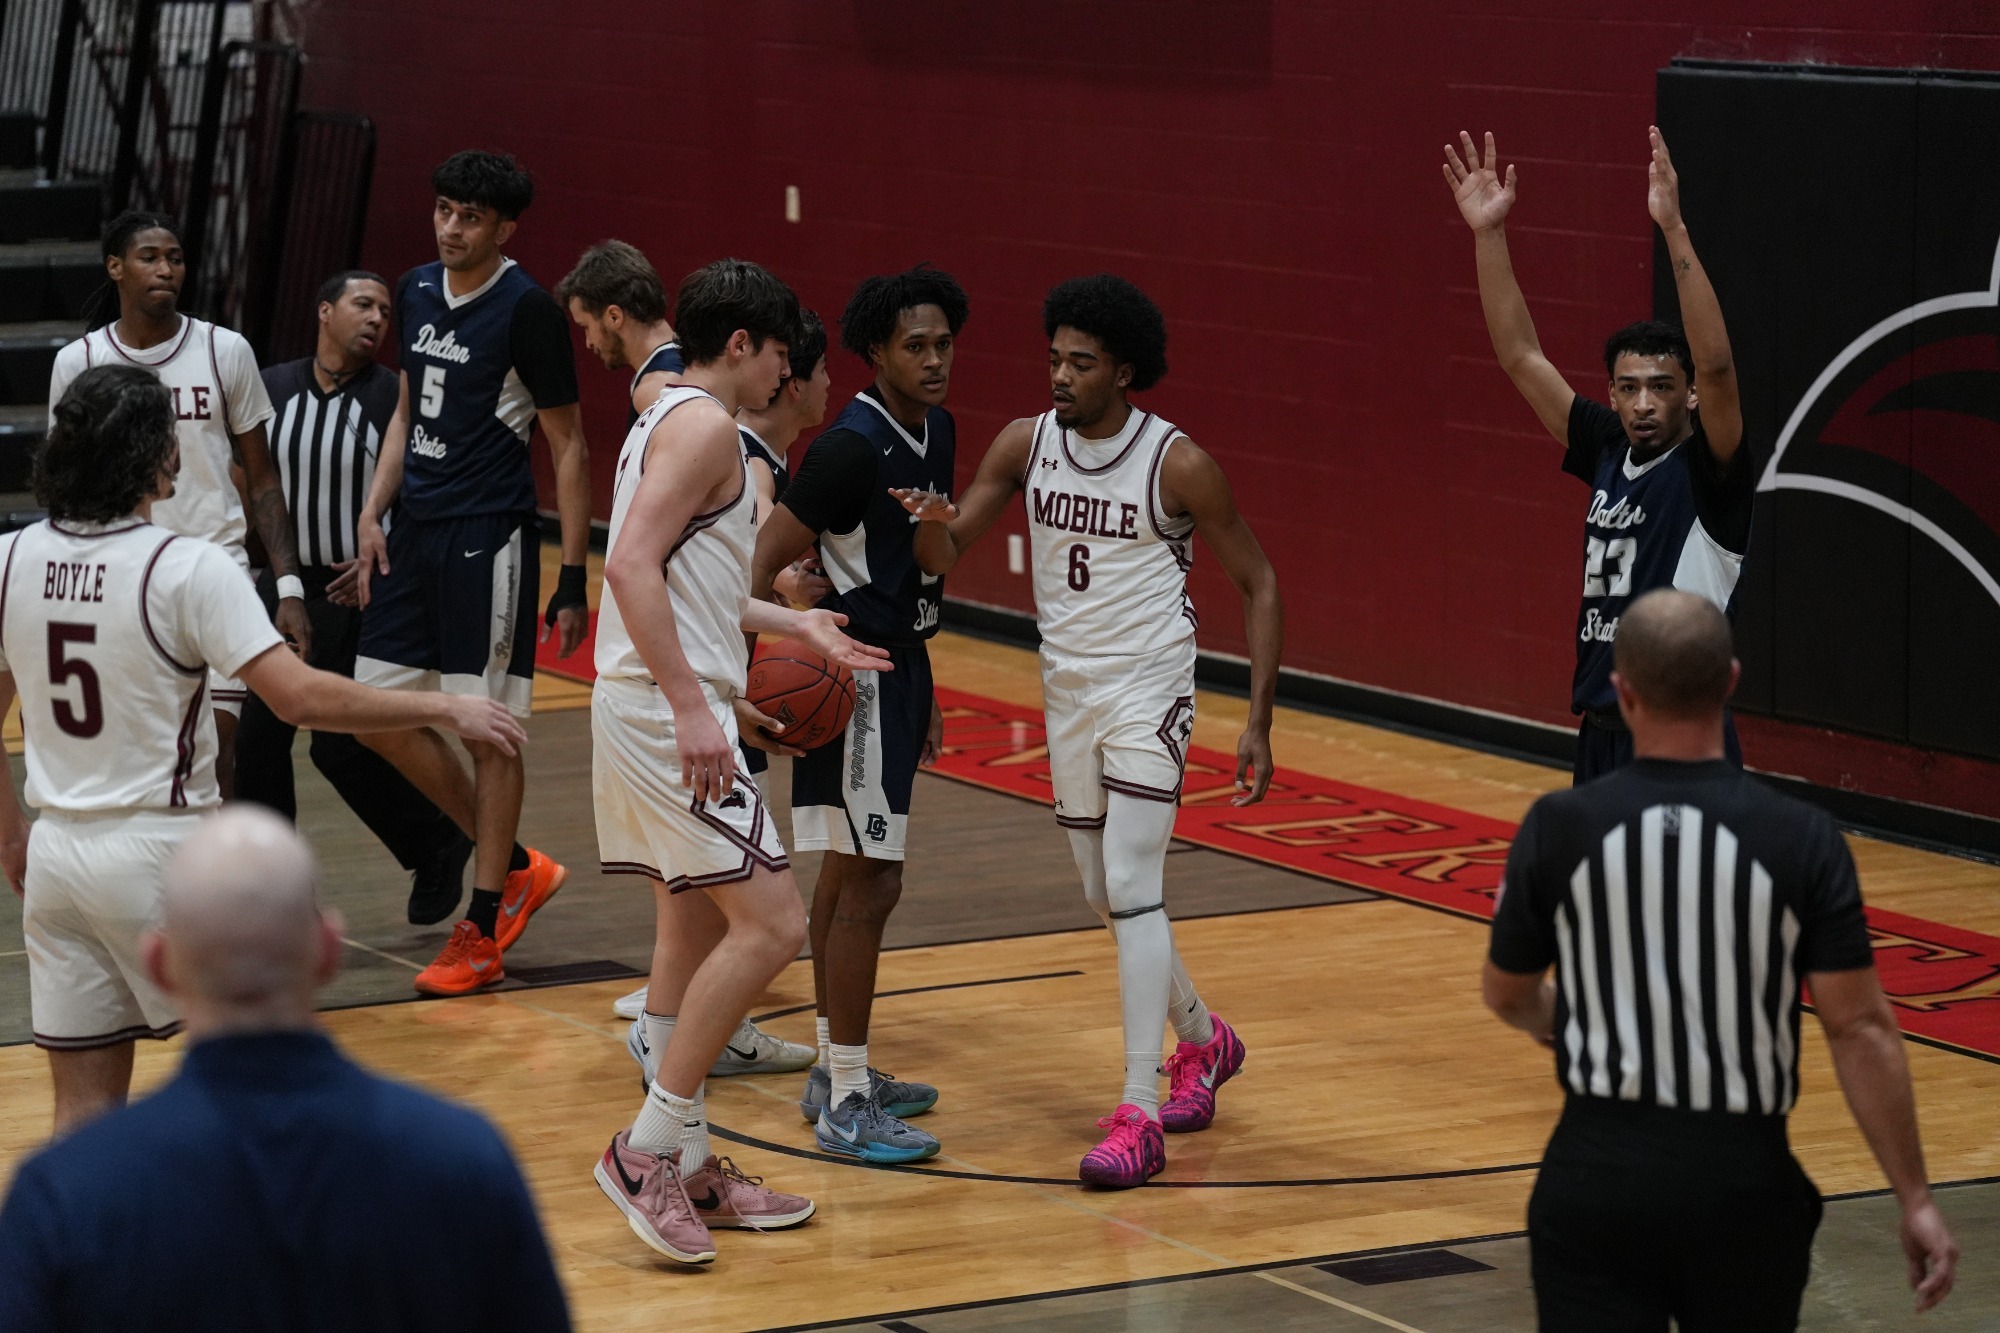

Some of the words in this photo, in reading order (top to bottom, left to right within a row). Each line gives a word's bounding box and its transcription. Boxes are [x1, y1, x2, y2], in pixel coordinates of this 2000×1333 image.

[411, 323, 470, 364] Dalton
[419, 364, 447, 419] 5
[411, 424, 447, 459] State
[1033, 487, 1138, 539] MOBILE
[44, 561, 106, 602] BOYLE
[1068, 543, 1090, 592] 6
[1583, 535, 1637, 598] 23
[1581, 607, 1619, 642] Stat
[47, 620, 104, 740] 5
[850, 679, 876, 792] Roadrunners
